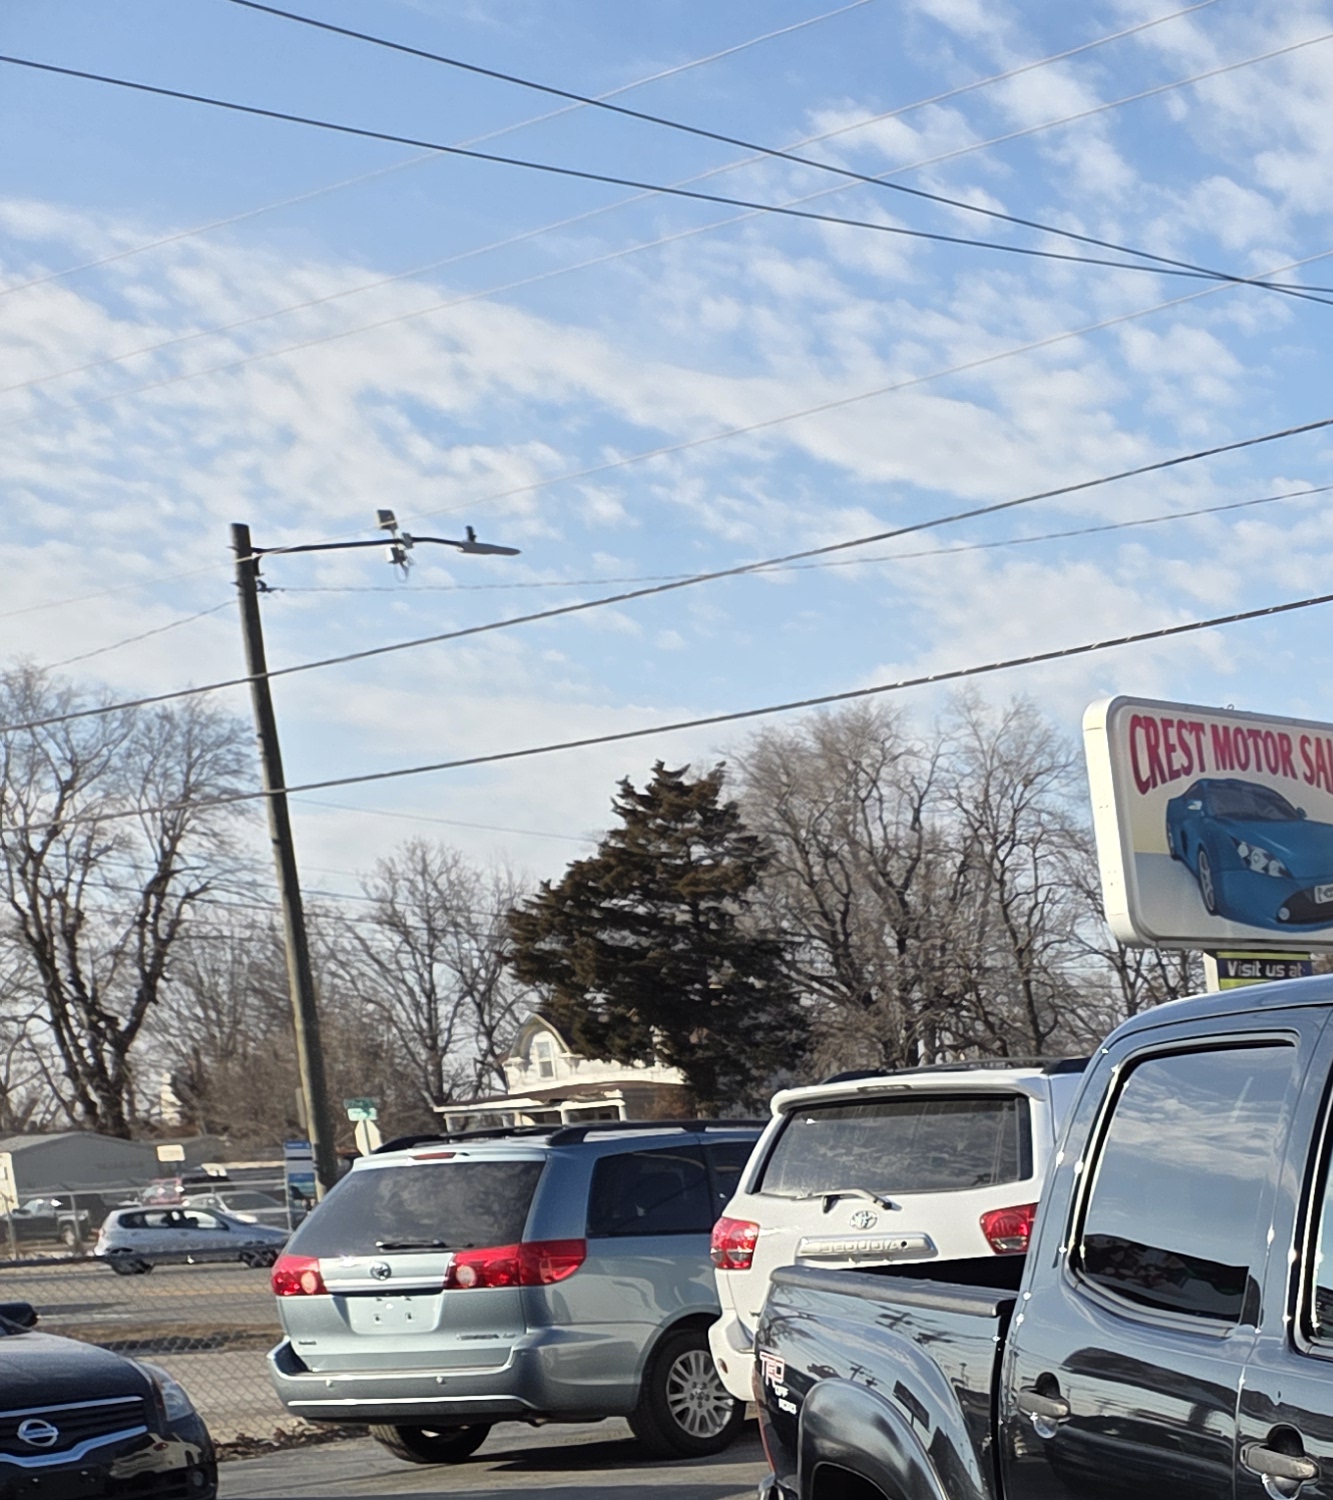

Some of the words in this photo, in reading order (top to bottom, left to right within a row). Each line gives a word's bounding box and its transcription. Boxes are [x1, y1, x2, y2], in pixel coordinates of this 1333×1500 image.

[1129, 714, 1206, 795] CREST
[1210, 723, 1298, 780] MOTOR
[1227, 961, 1261, 977] Visit
[1265, 964, 1285, 977] us
